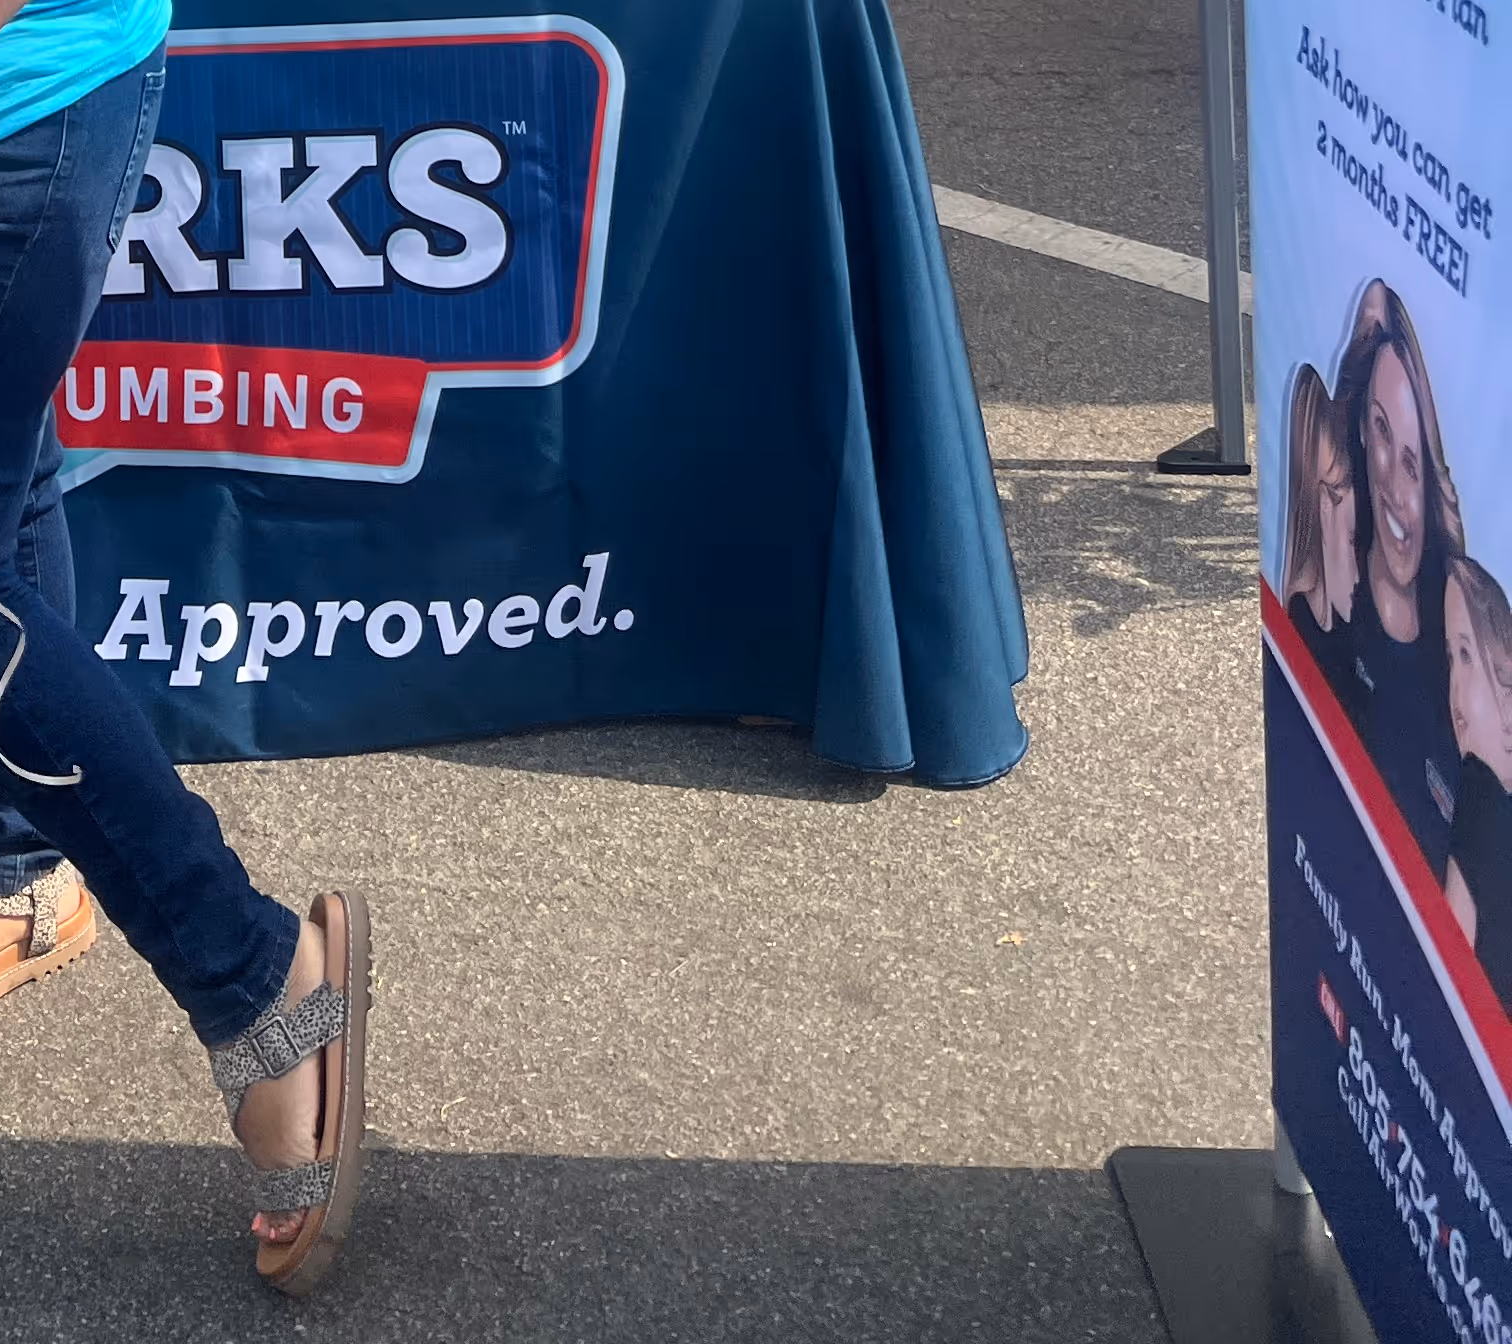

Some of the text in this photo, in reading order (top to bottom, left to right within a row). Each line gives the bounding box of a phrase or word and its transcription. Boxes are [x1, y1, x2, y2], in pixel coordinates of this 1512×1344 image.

[1296, 23, 1493, 241] Ask how you can get
[1316, 119, 1469, 299] 2 months FREE!
[65, 365, 365, 434] UMBING
[95, 552, 635, 687] Approved.
[1295, 833, 1512, 1260] Family Run. Mom Approv
